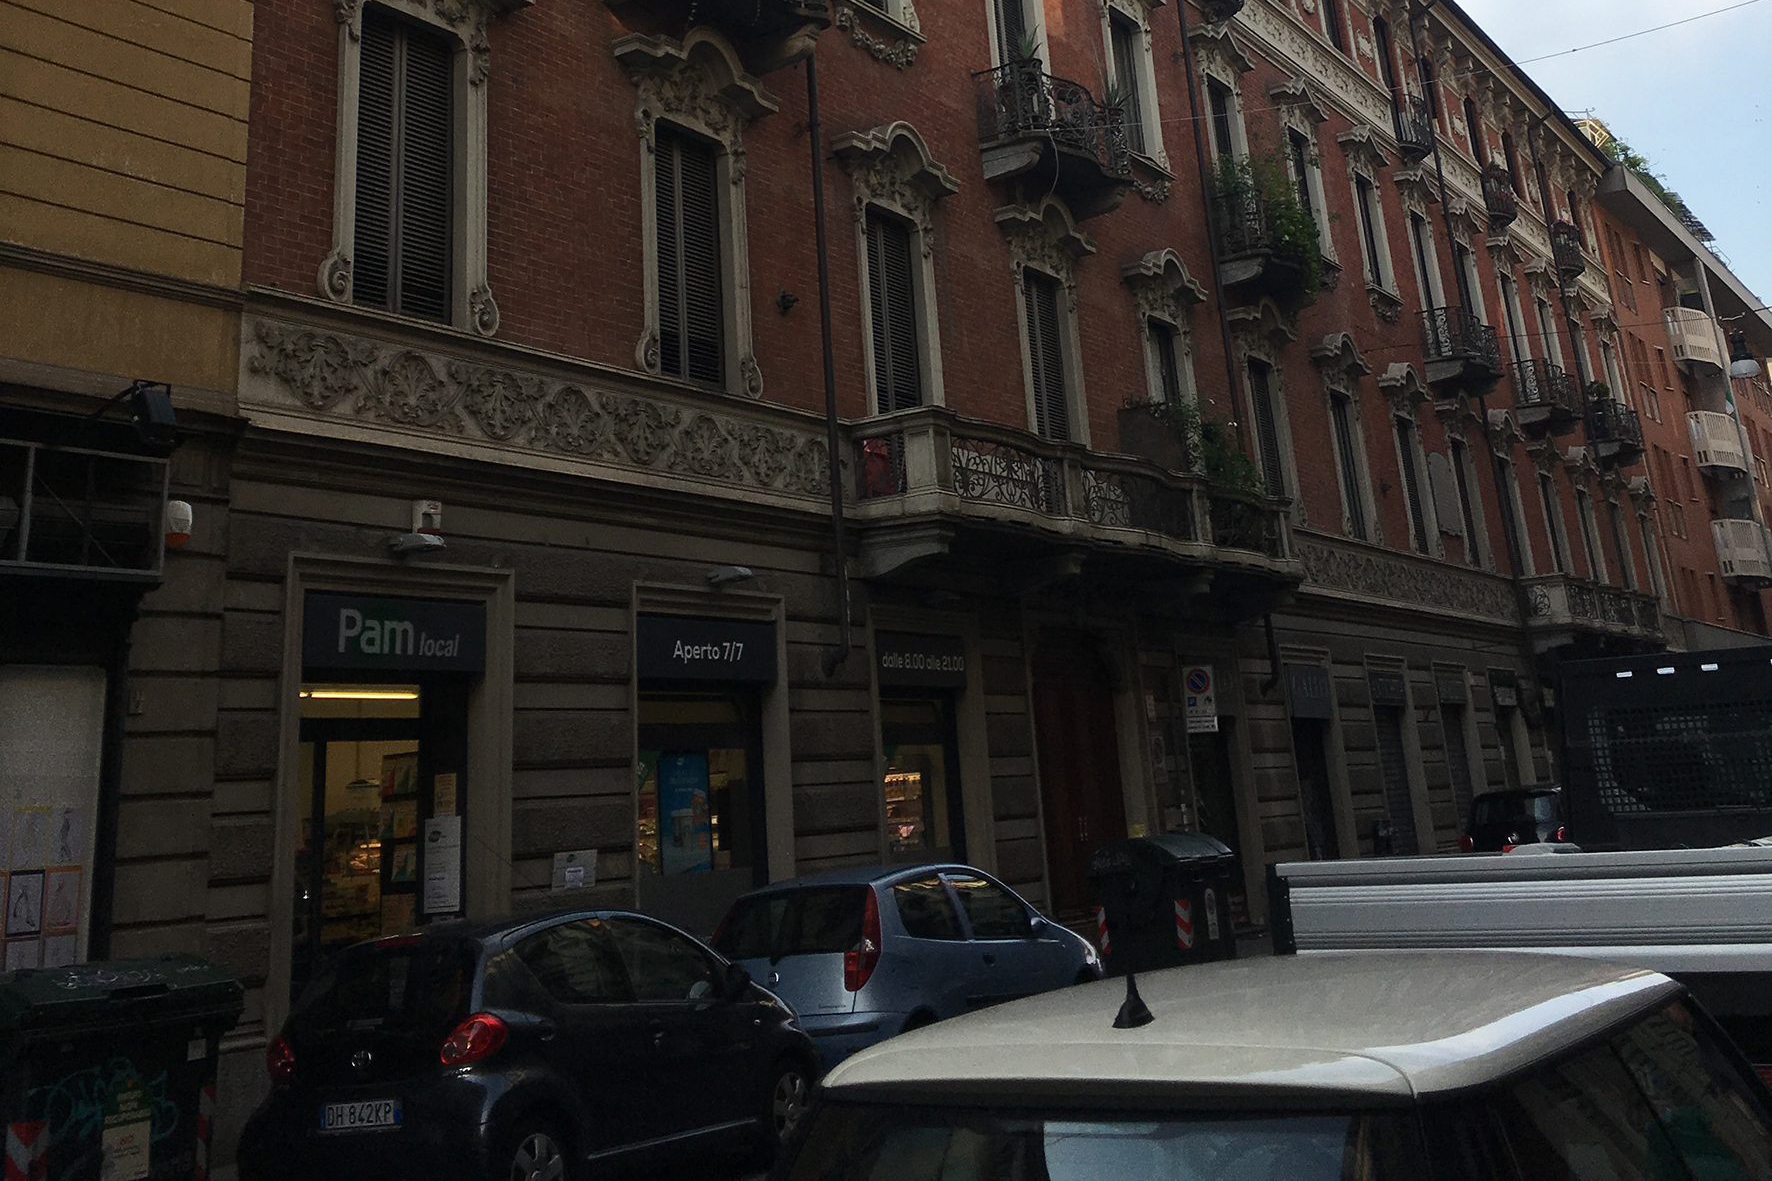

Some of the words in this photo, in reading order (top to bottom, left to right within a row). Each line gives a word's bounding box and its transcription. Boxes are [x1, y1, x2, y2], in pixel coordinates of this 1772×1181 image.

[338, 608, 414, 655] Pam
[419, 631, 460, 657] local
[673, 640, 720, 664] Aperto
[722, 641, 744, 662] 7/7
[882, 651, 903, 668] dalle
[904, 653, 925, 669] 8.00
[926, 654, 941, 671] alle
[327, 1106, 344, 1126] DH
[348, 1103, 392, 1124] 842KP
